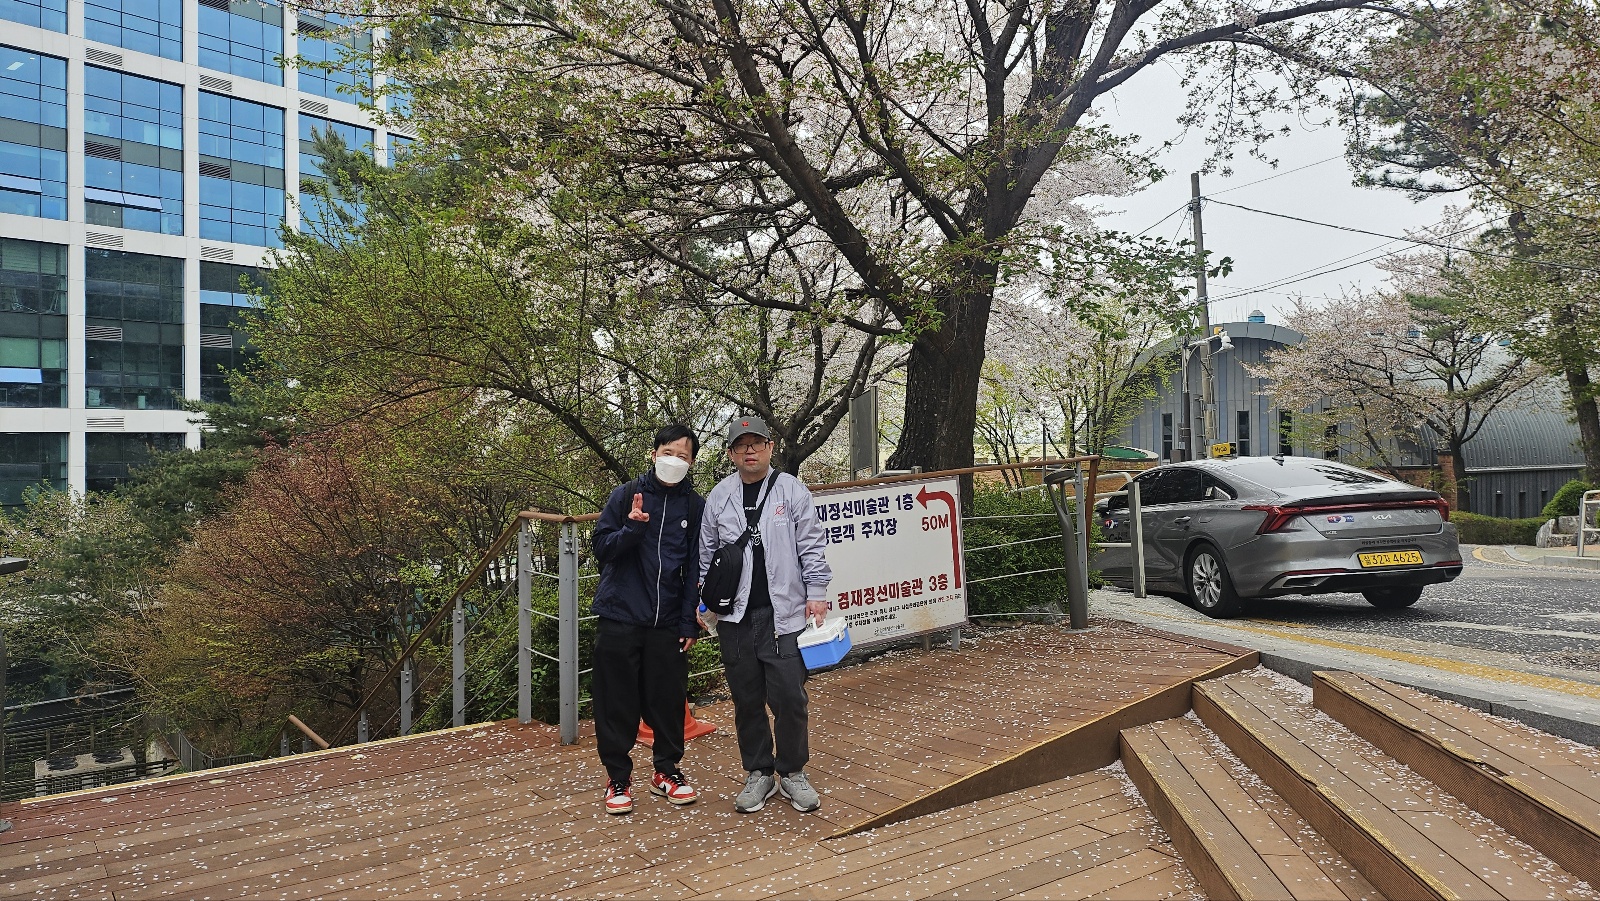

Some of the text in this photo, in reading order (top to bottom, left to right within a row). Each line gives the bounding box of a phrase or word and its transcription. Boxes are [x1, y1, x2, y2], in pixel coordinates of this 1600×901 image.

[896, 493, 914, 511] 1층
[861, 518, 898, 539] 주차장
[921, 514, 949, 532] 50M
[1392, 552, 1419, 564] 4625
[838, 577, 923, 610] 겸재정선미술관
[928, 573, 948, 592] 3층
